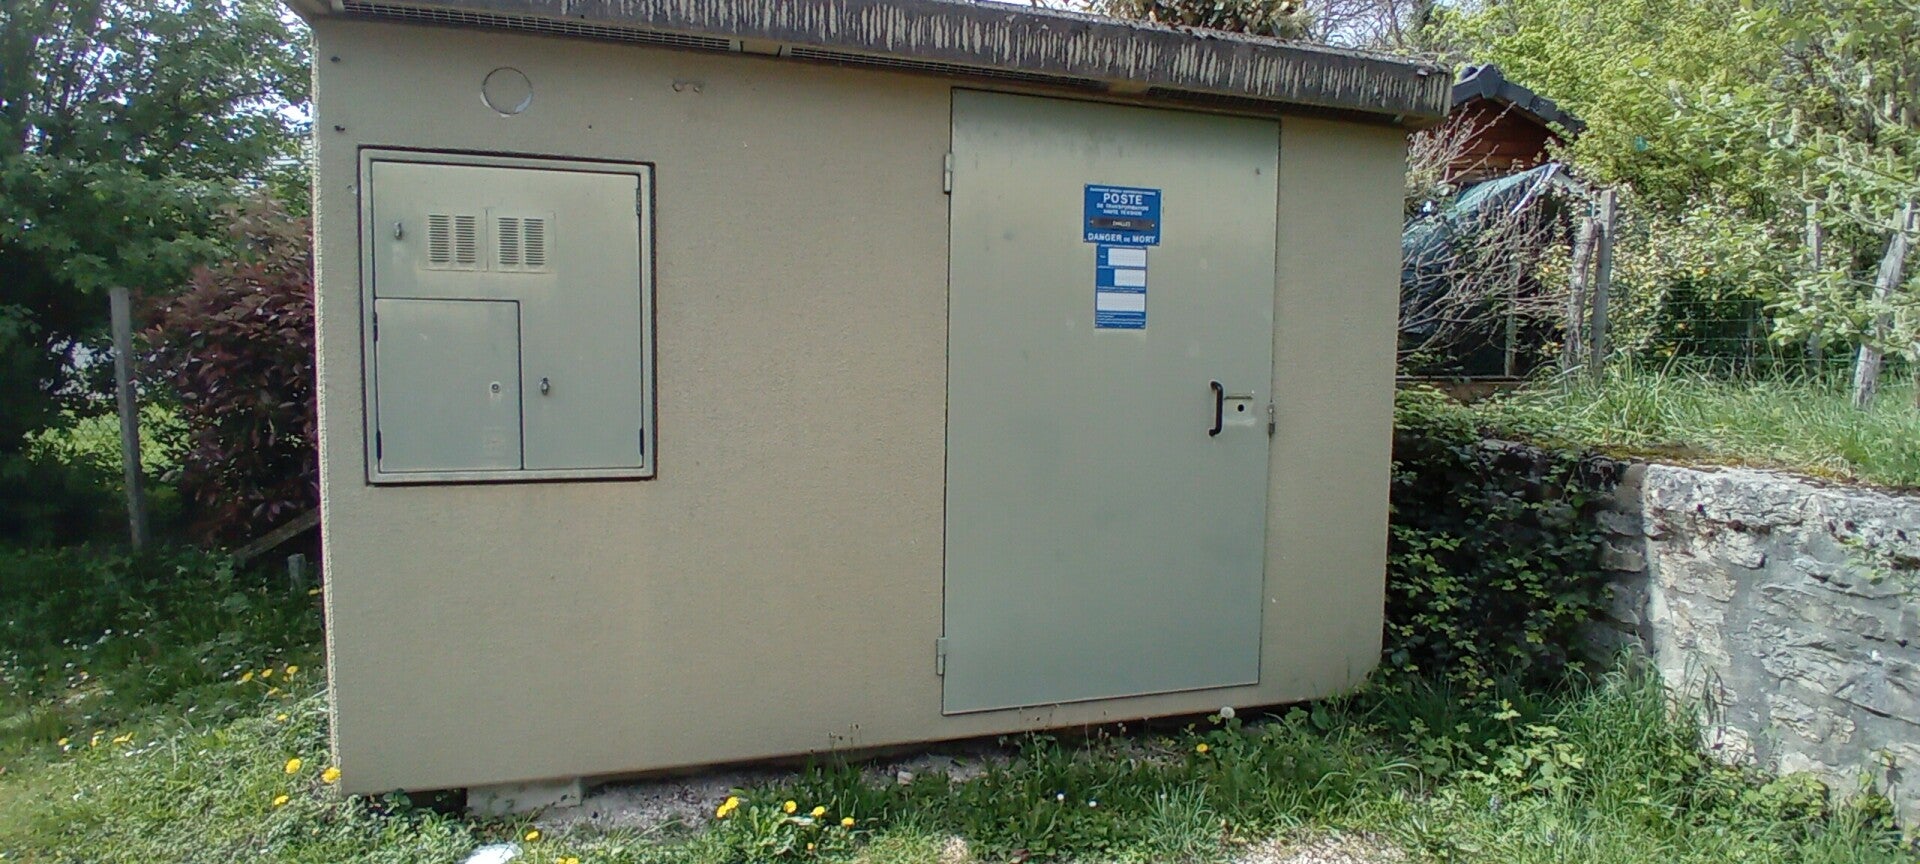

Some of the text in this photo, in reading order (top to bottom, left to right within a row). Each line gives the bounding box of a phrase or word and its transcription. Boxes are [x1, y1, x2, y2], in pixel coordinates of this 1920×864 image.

[1103, 193, 1143, 205] POSTE
[1105, 203, 1149, 211] TRANSFORMATION
[1088, 233, 1122, 242] DANGER
[1132, 235, 1156, 243] MORT
